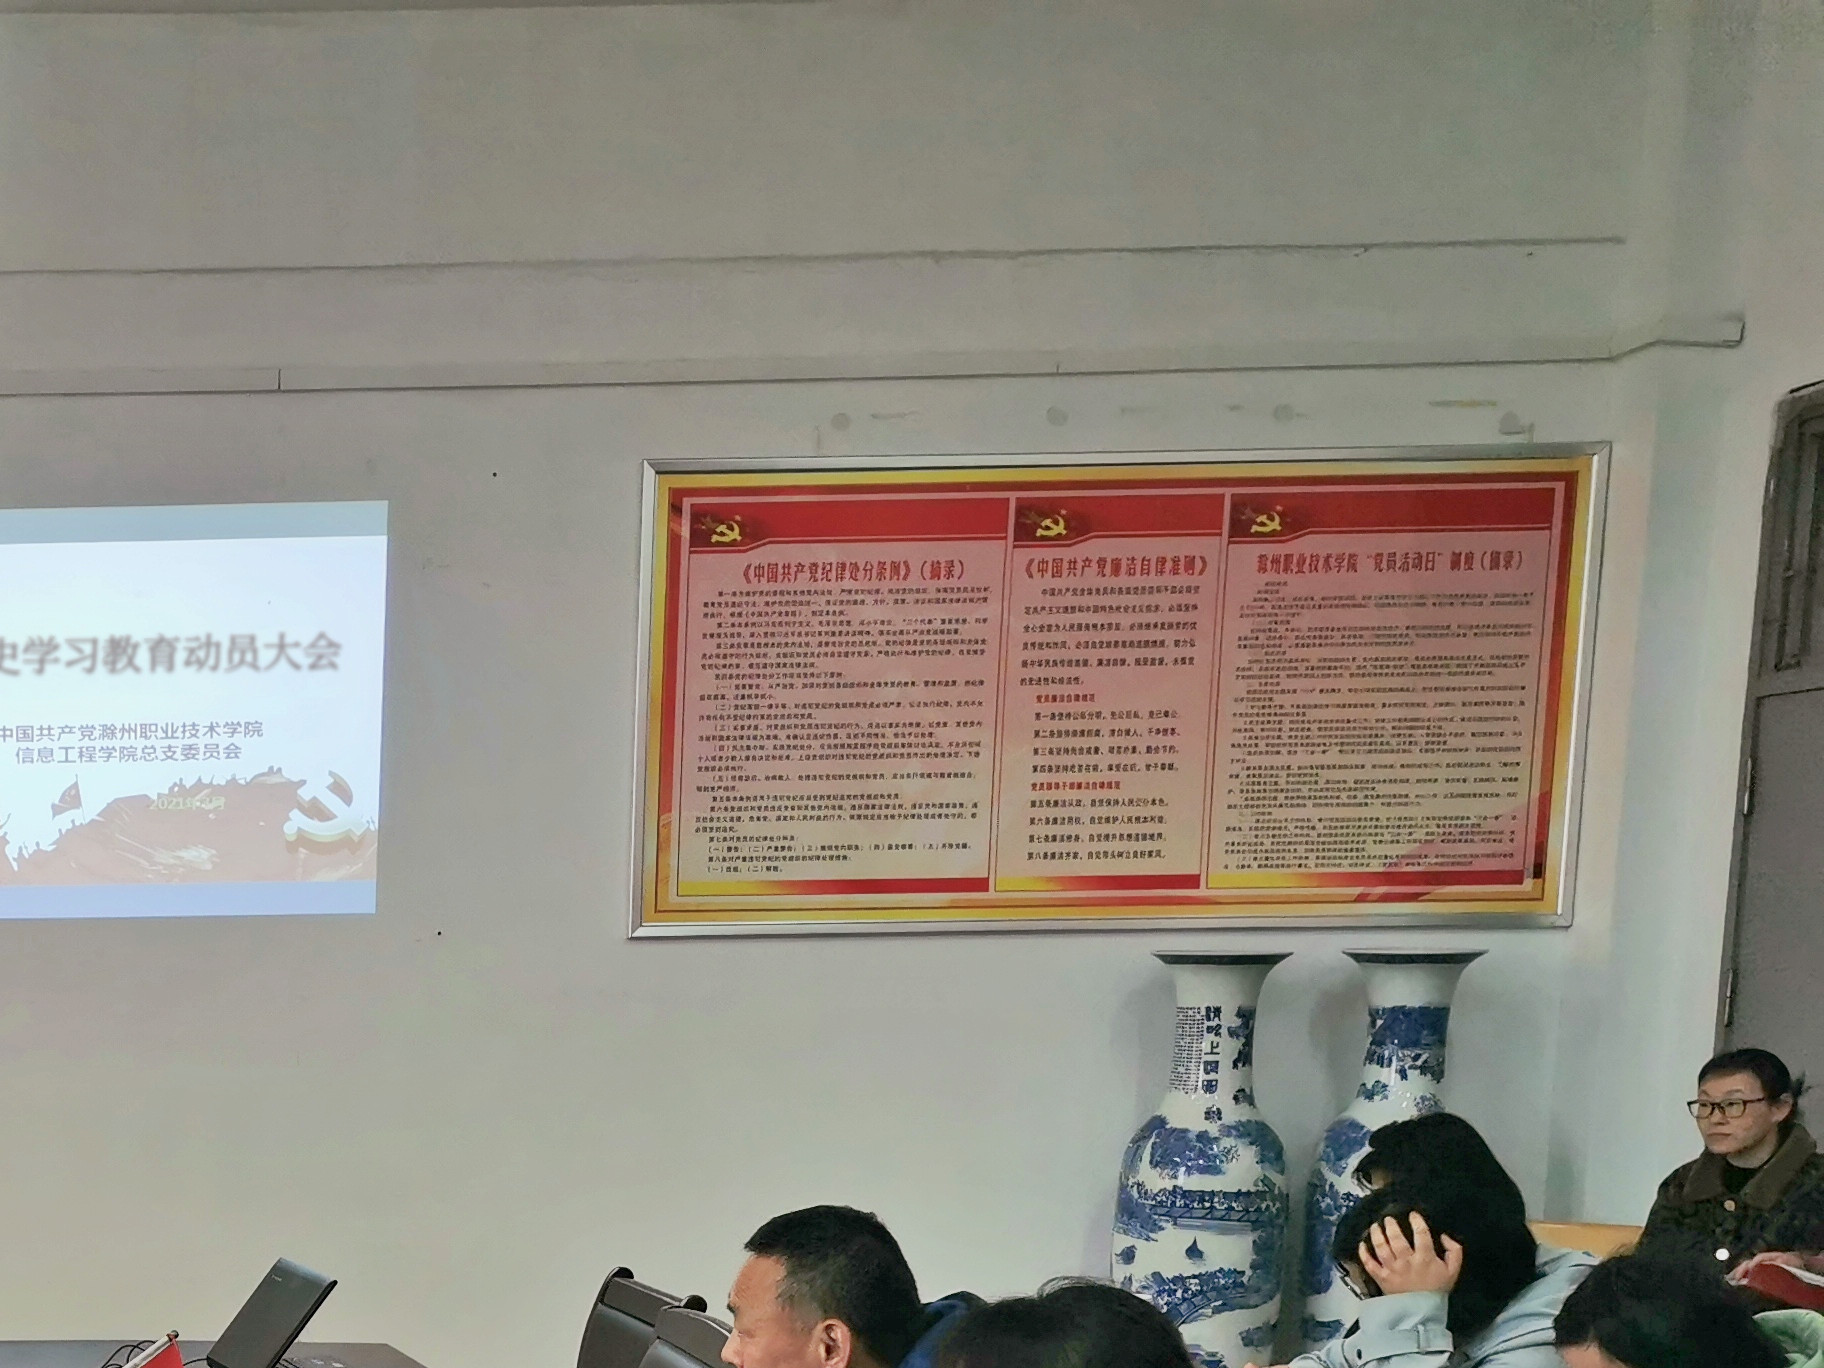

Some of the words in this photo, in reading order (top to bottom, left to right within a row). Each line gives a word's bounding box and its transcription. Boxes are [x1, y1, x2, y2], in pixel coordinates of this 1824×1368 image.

[1025, 555, 1207, 578] 《中国共产党廉洁自律准则》
[15, 742, 243, 765] 信息工程学院总支委员会
